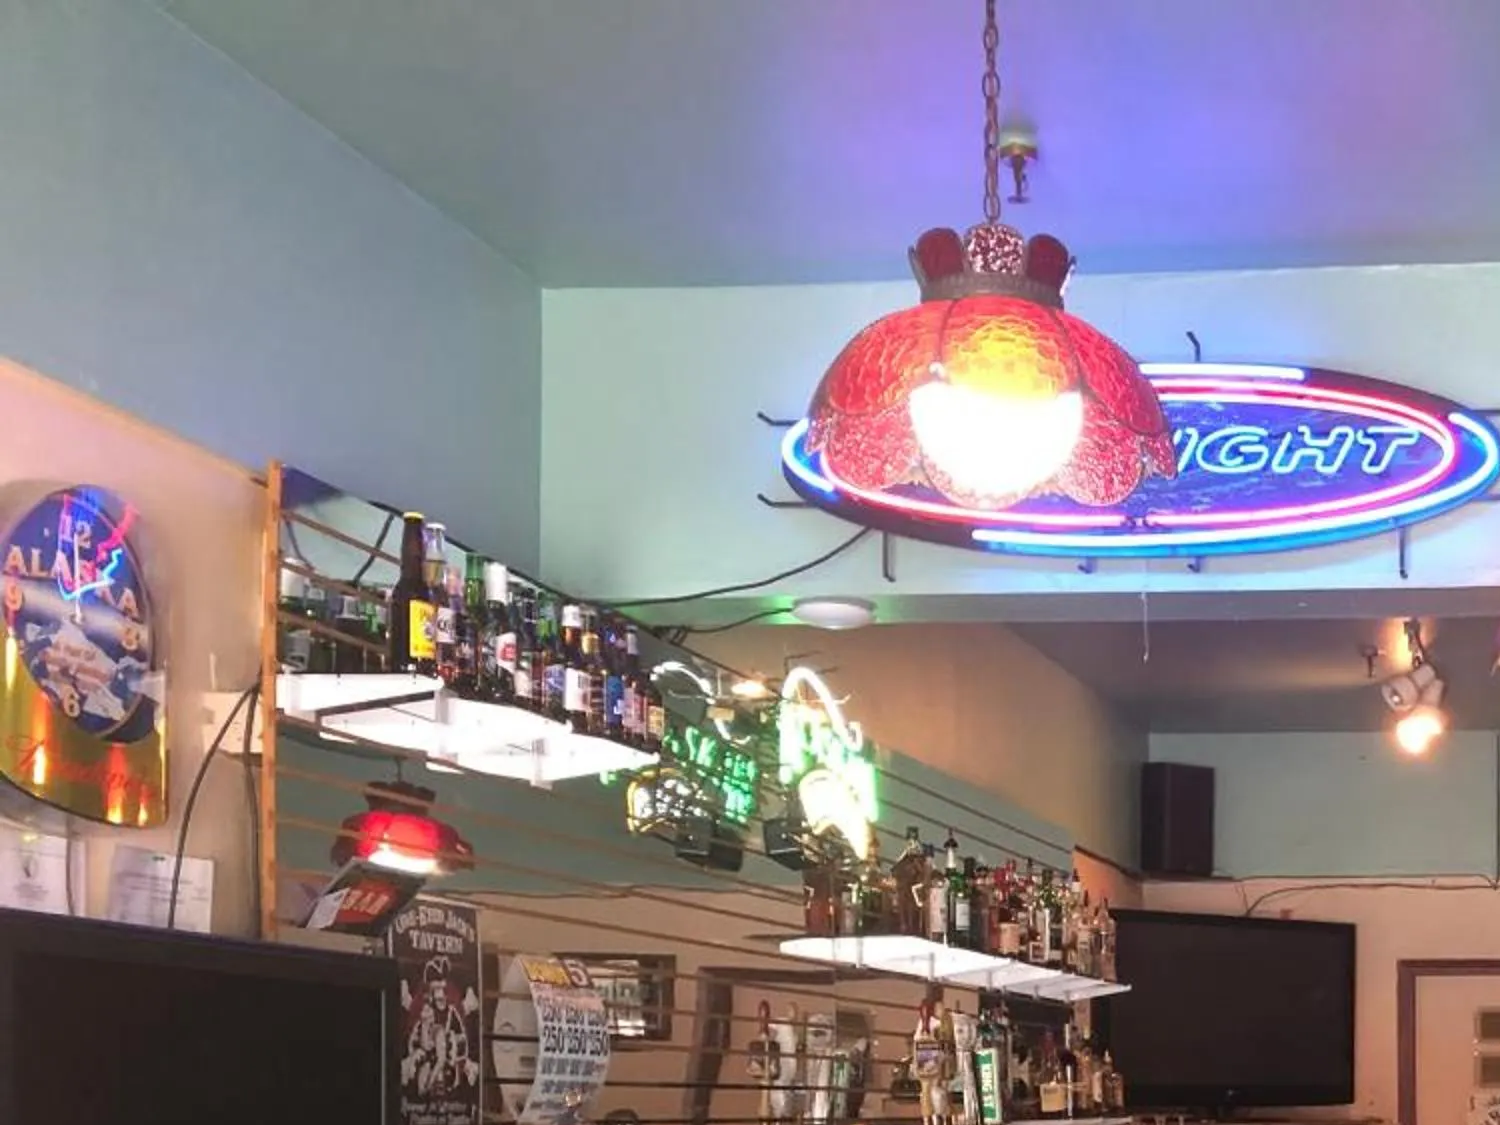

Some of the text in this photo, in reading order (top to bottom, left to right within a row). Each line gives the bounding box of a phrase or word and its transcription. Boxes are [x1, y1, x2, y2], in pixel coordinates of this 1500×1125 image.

[1173, 425, 1421, 475] IGHT
[62, 686, 80, 717] 6
[409, 929, 463, 955] TAVERN
